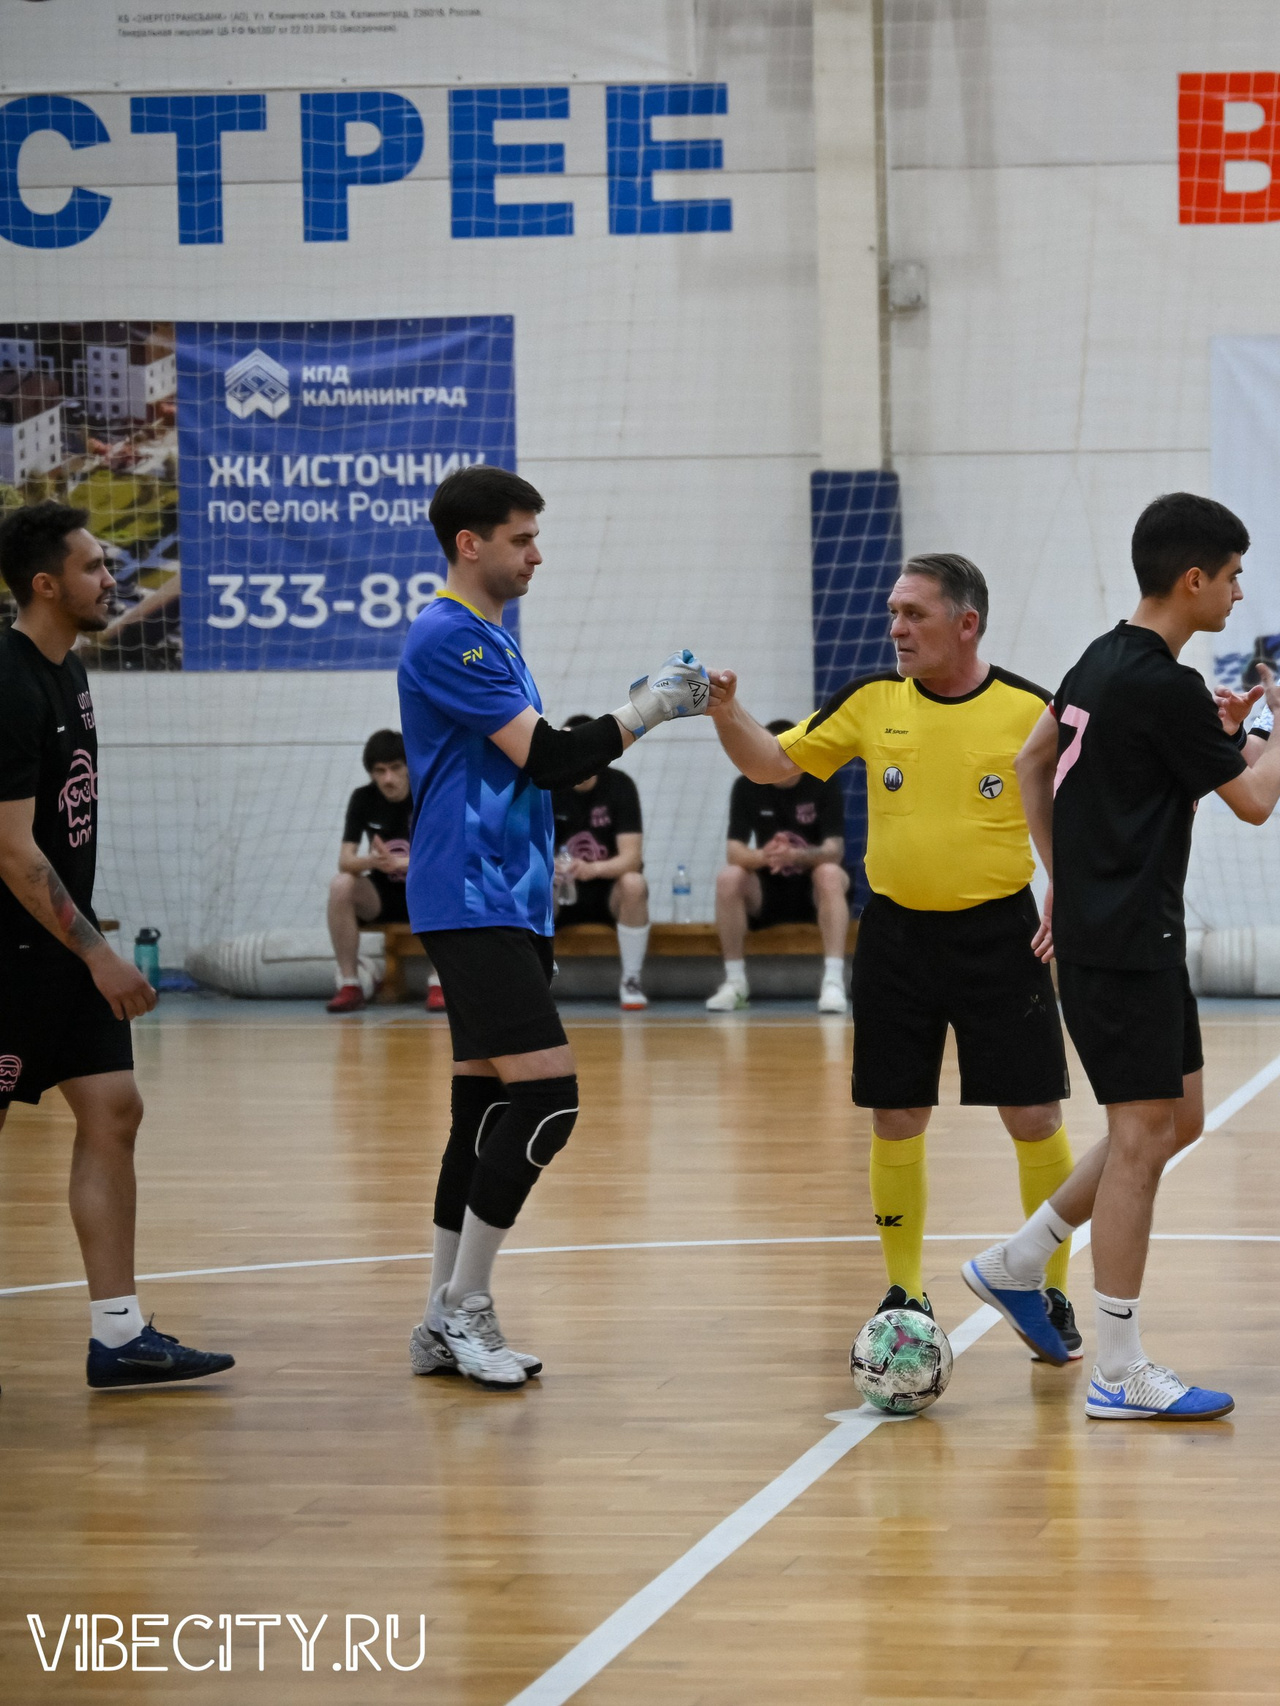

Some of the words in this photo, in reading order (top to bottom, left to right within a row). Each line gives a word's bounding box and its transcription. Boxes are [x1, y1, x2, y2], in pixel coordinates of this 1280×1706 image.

[302, 365, 350, 386] КПД
[302, 386, 468, 408] КАЛИНИНГРАД
[208, 456, 271, 488] ЖК
[208, 498, 339, 524] поселок
[349, 492, 430, 527] Родн
[207, 573, 447, 630] 333-88
[1053, 703, 1091, 799] 7
